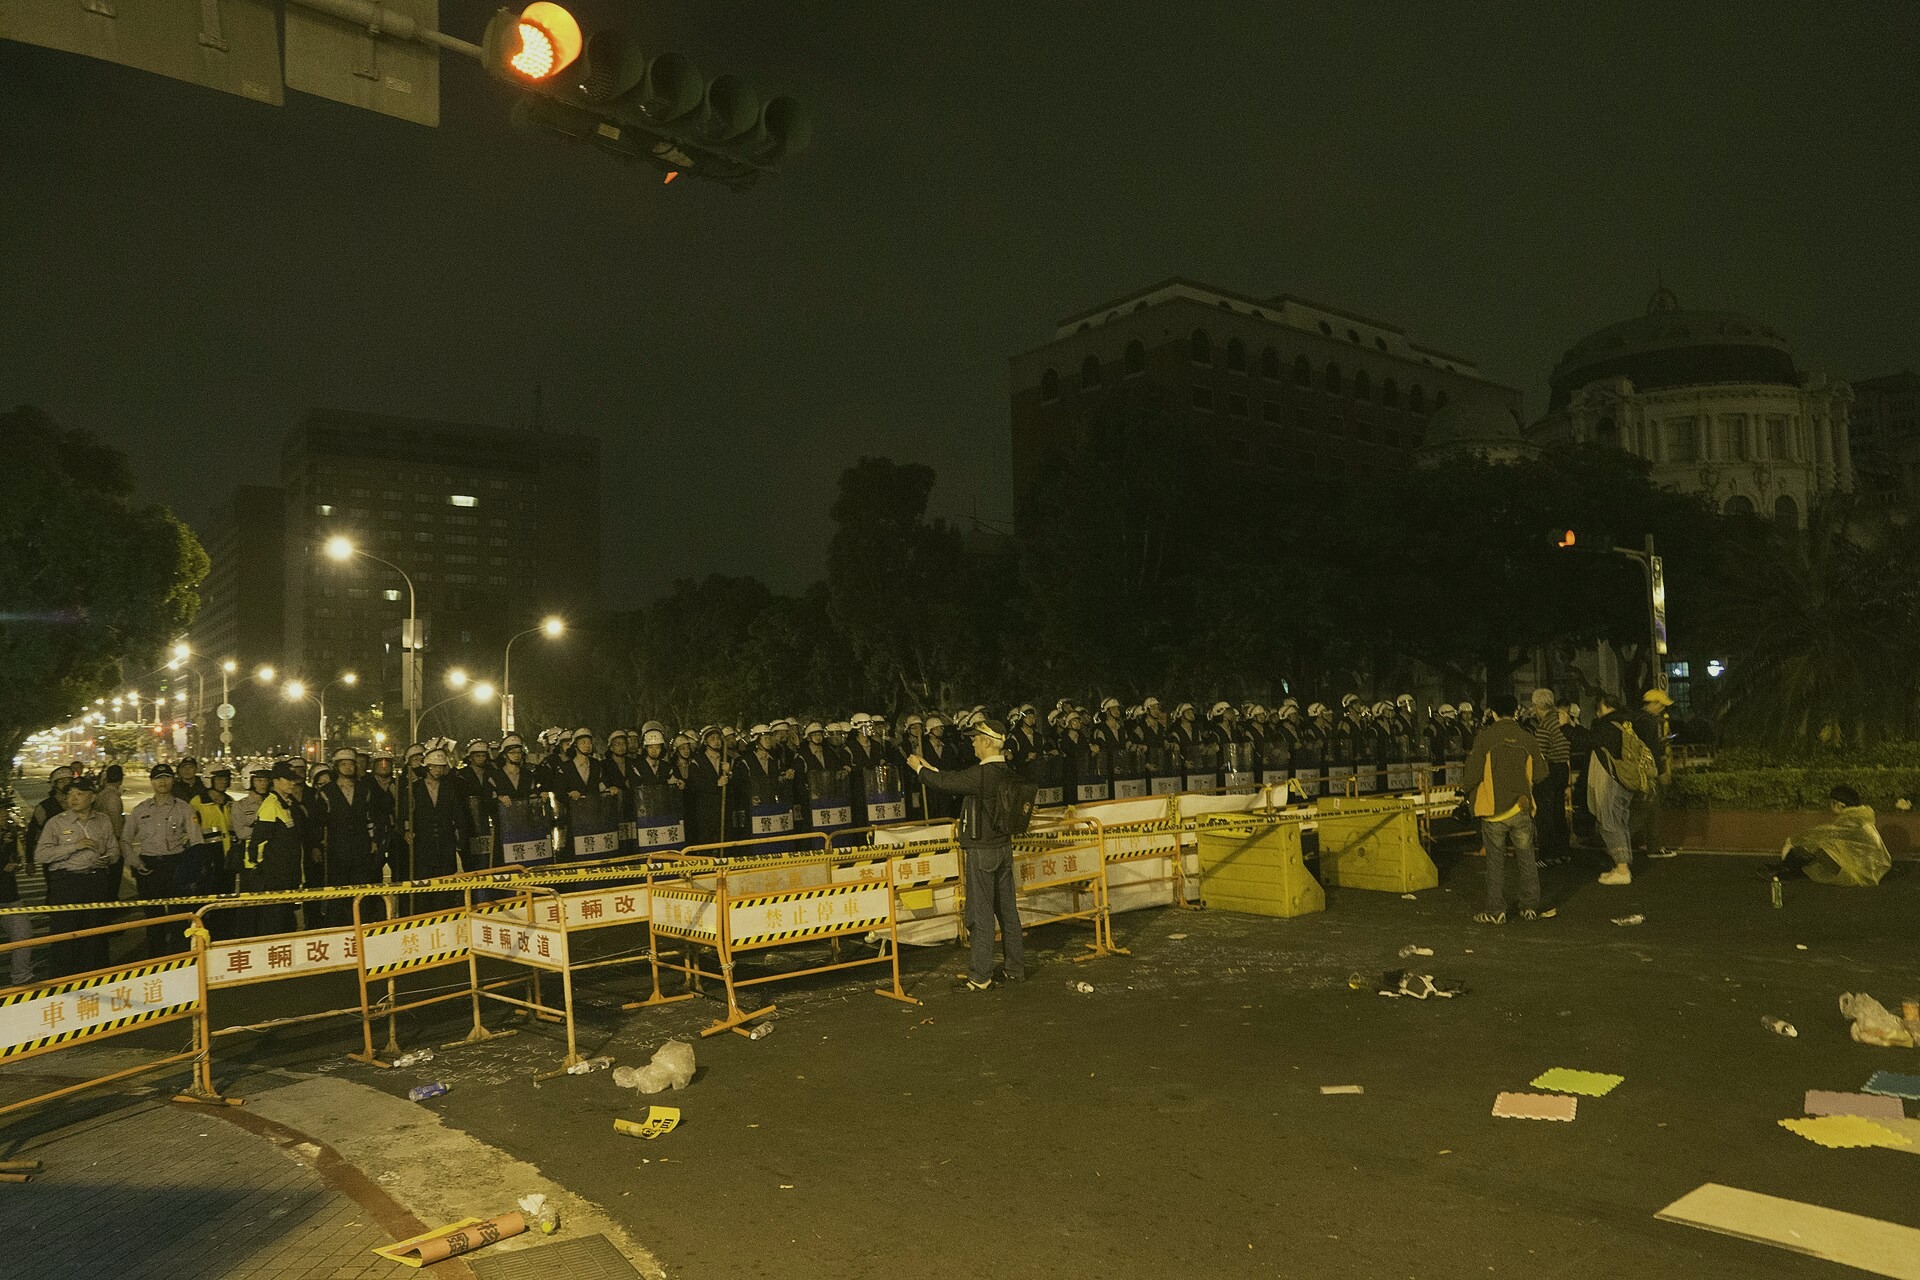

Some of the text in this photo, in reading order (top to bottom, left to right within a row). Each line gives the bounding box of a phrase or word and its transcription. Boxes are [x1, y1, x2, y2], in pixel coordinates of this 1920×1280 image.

[820, 808, 848, 825] 警察
[874, 802, 902, 819] 警察
[760, 814, 790, 832] 警察
[583, 833, 614, 853] 警察
[647, 826, 679, 844] 警察
[512, 841, 546, 860] 警察
[764, 898, 860, 929] 禁止停車
[482, 925, 551, 958] 車輛改道
[40, 978, 164, 1029] 車輛改道
